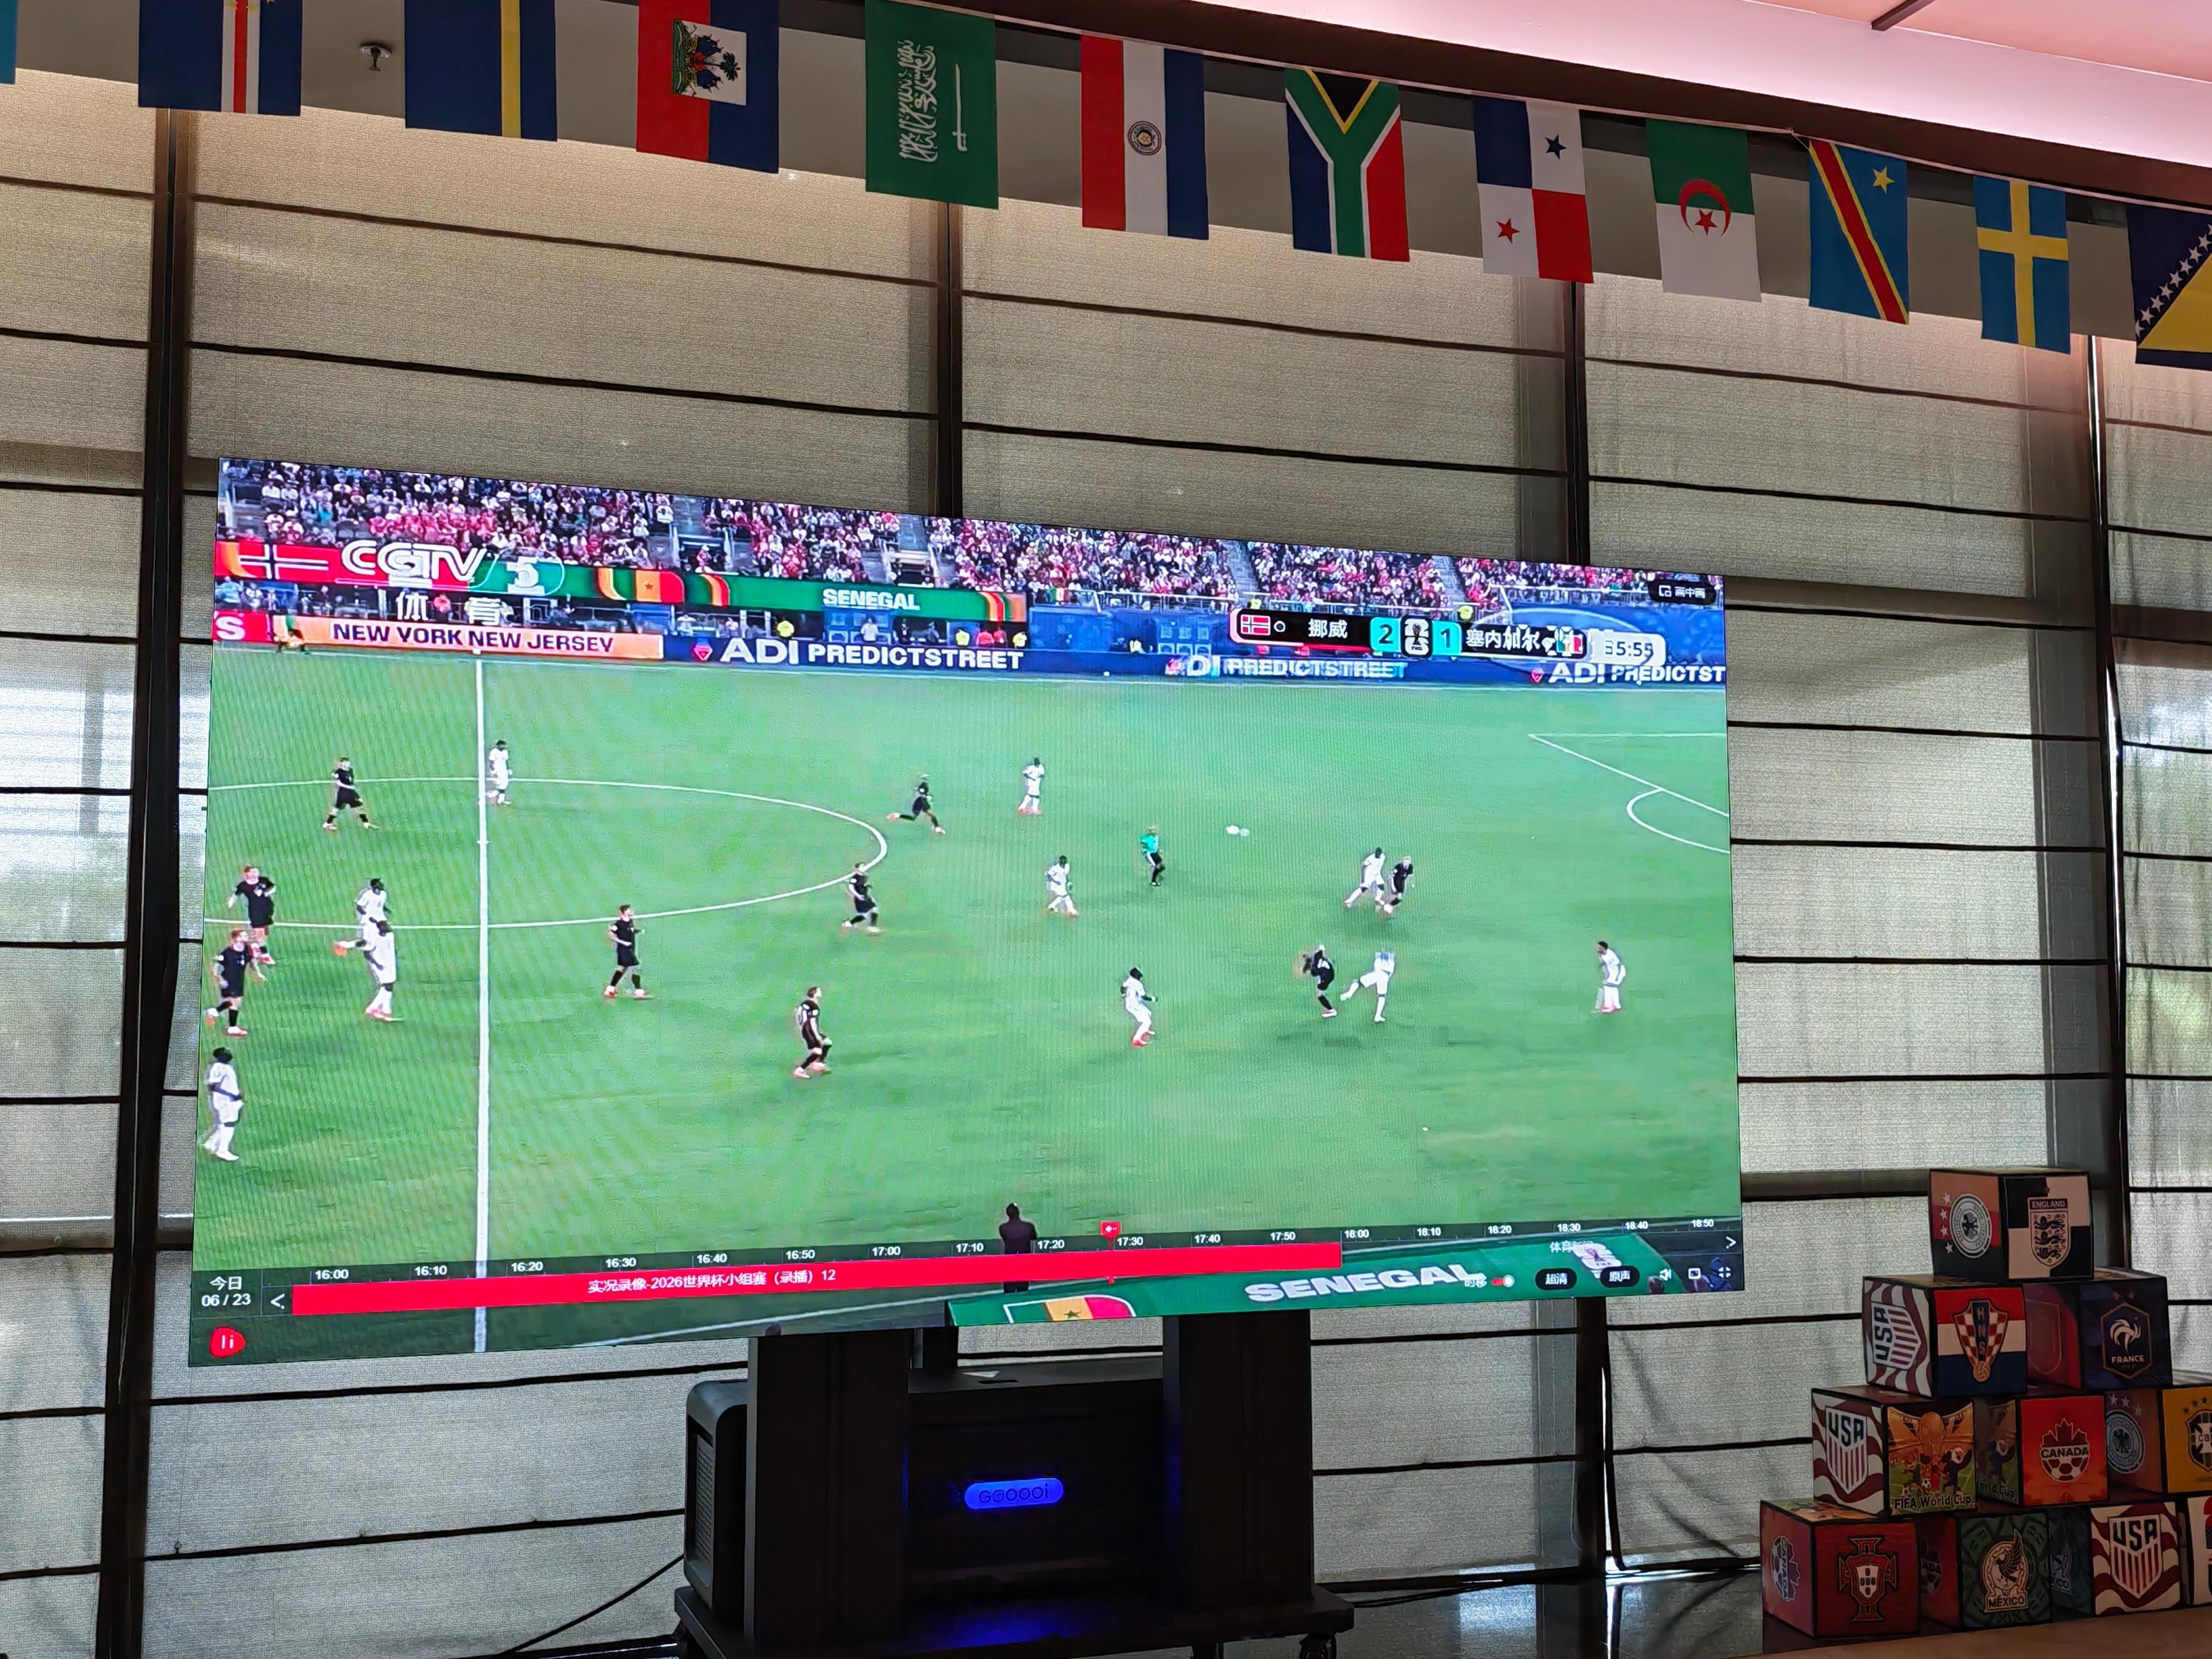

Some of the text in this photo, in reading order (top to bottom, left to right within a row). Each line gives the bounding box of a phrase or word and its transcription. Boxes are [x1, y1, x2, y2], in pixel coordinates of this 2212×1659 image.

[823, 588, 920, 611] SENEGAL
[1674, 586, 1706, 599] 画中画
[396, 591, 501, 625] 体育
[216, 616, 245, 640] S
[333, 623, 615, 653] NEW YORK NEW JERSEY
[1307, 618, 1348, 639] 挪威
[1379, 624, 1394, 644] 2
[1440, 628, 1451, 648] 1
[1466, 625, 1540, 652] 塞内加尔
[720, 638, 1024, 670] ADI PREDICTSTREET
[1167, 655, 1408, 678] DI PREDICTSTREET
[2032, 1199, 2066, 1209] ENGLAND
[315, 1218, 1714, 1280] 16:00 16:10 16:20 16:30 16:40 16:50 17:00 17:10 17:20 17:30 17:40 17:50 18:00 18:10 18:20 18:30 18:40 18:50
[210, 1276, 242, 1290] 今日
[1245, 1263, 1485, 1302] SENEGAL
[1873, 1306, 1893, 1361] USA
[2110, 1354, 2145, 1364] FRANCE
[1828, 1412, 1864, 1447] USA
[2198, 1434, 2212, 1442] CB
[2040, 1446, 2089, 1458] CANADA
[1894, 1494, 1972, 1509] FIFA World Cup
[2113, 1519, 2158, 1552] USA
[1988, 1593, 2025, 1608] MÉXICO
